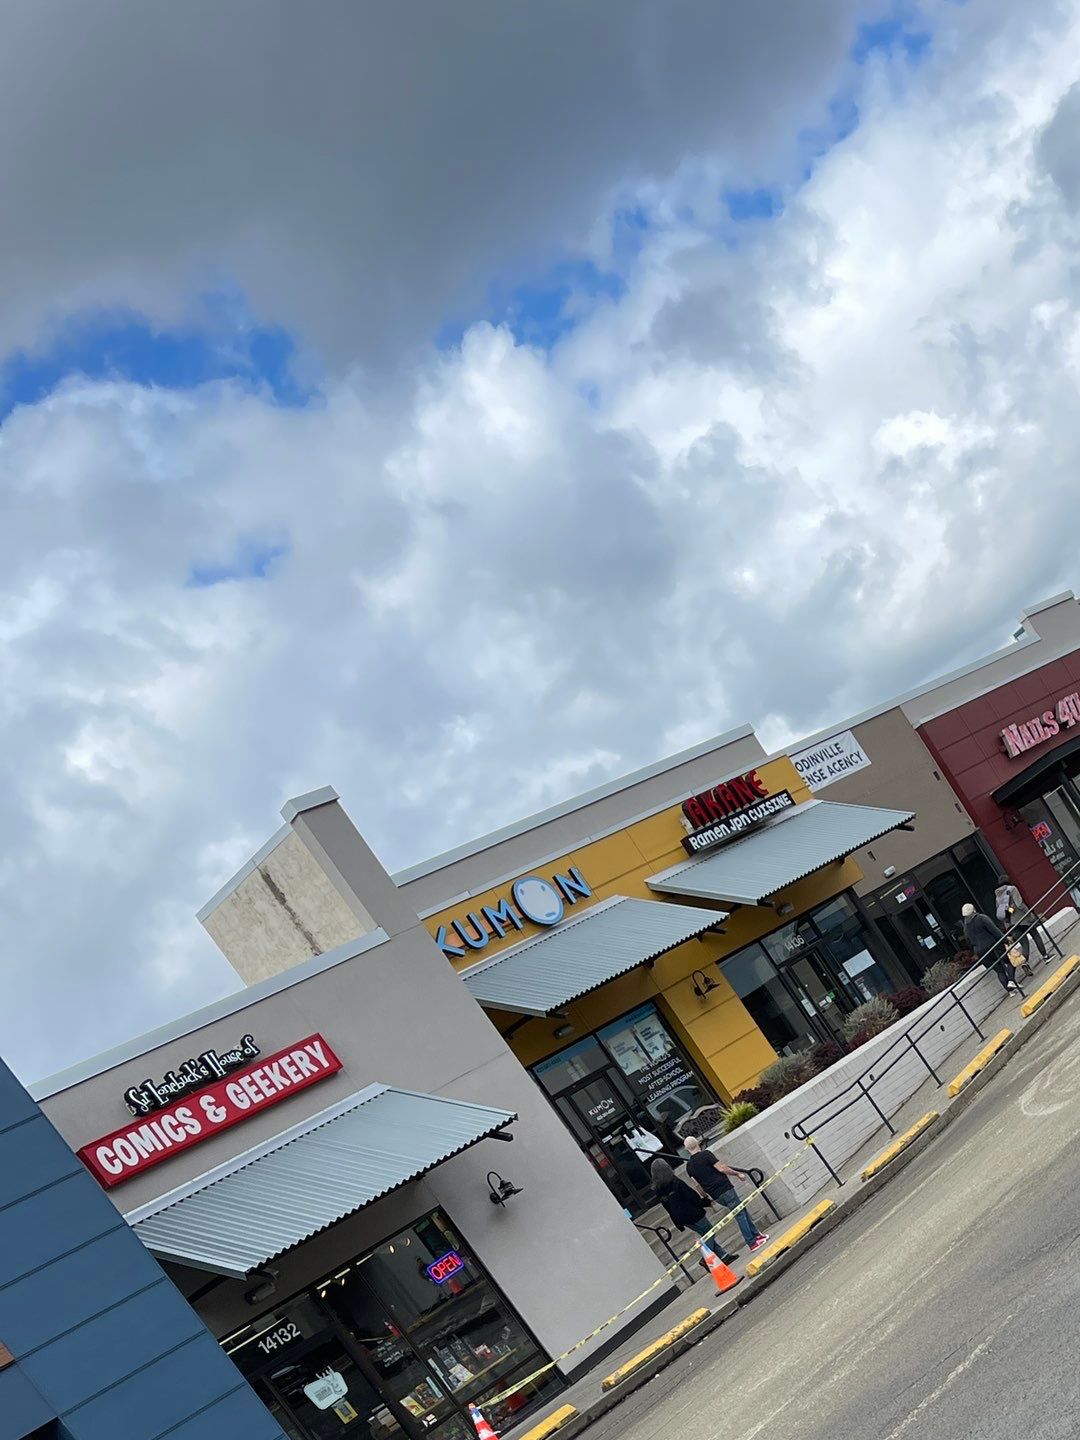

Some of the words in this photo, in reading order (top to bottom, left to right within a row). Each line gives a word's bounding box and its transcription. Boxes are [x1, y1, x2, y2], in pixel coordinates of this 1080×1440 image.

[1000, 711, 1060, 759] NAILS
[829, 750, 864, 778] AGENCY
[684, 769, 770, 830] AKANE
[689, 821, 731, 850] Ramen
[749, 792, 793, 822] CUISINE
[436, 865, 593, 959] KUMON
[784, 934, 806, 952] 14136
[203, 1049, 244, 1079] House
[243, 1035, 261, 1057] of
[638, 1073, 653, 1086] MOST
[651, 1056, 683, 1079] SUCCESSFUL
[646, 1085, 672, 1103] LEARNING
[669, 1071, 695, 1090] PROGRAM
[647, 1068, 684, 1091] AFTER-SCHOOL
[96, 1106, 203, 1176] COMICS
[199, 1094, 228, 1125] &
[225, 1040, 331, 1111] GEEKERY
[588, 1097, 615, 1118] KUMON
[430, 1252, 463, 1281] OPEN
[257, 1321, 302, 1355] 14132
